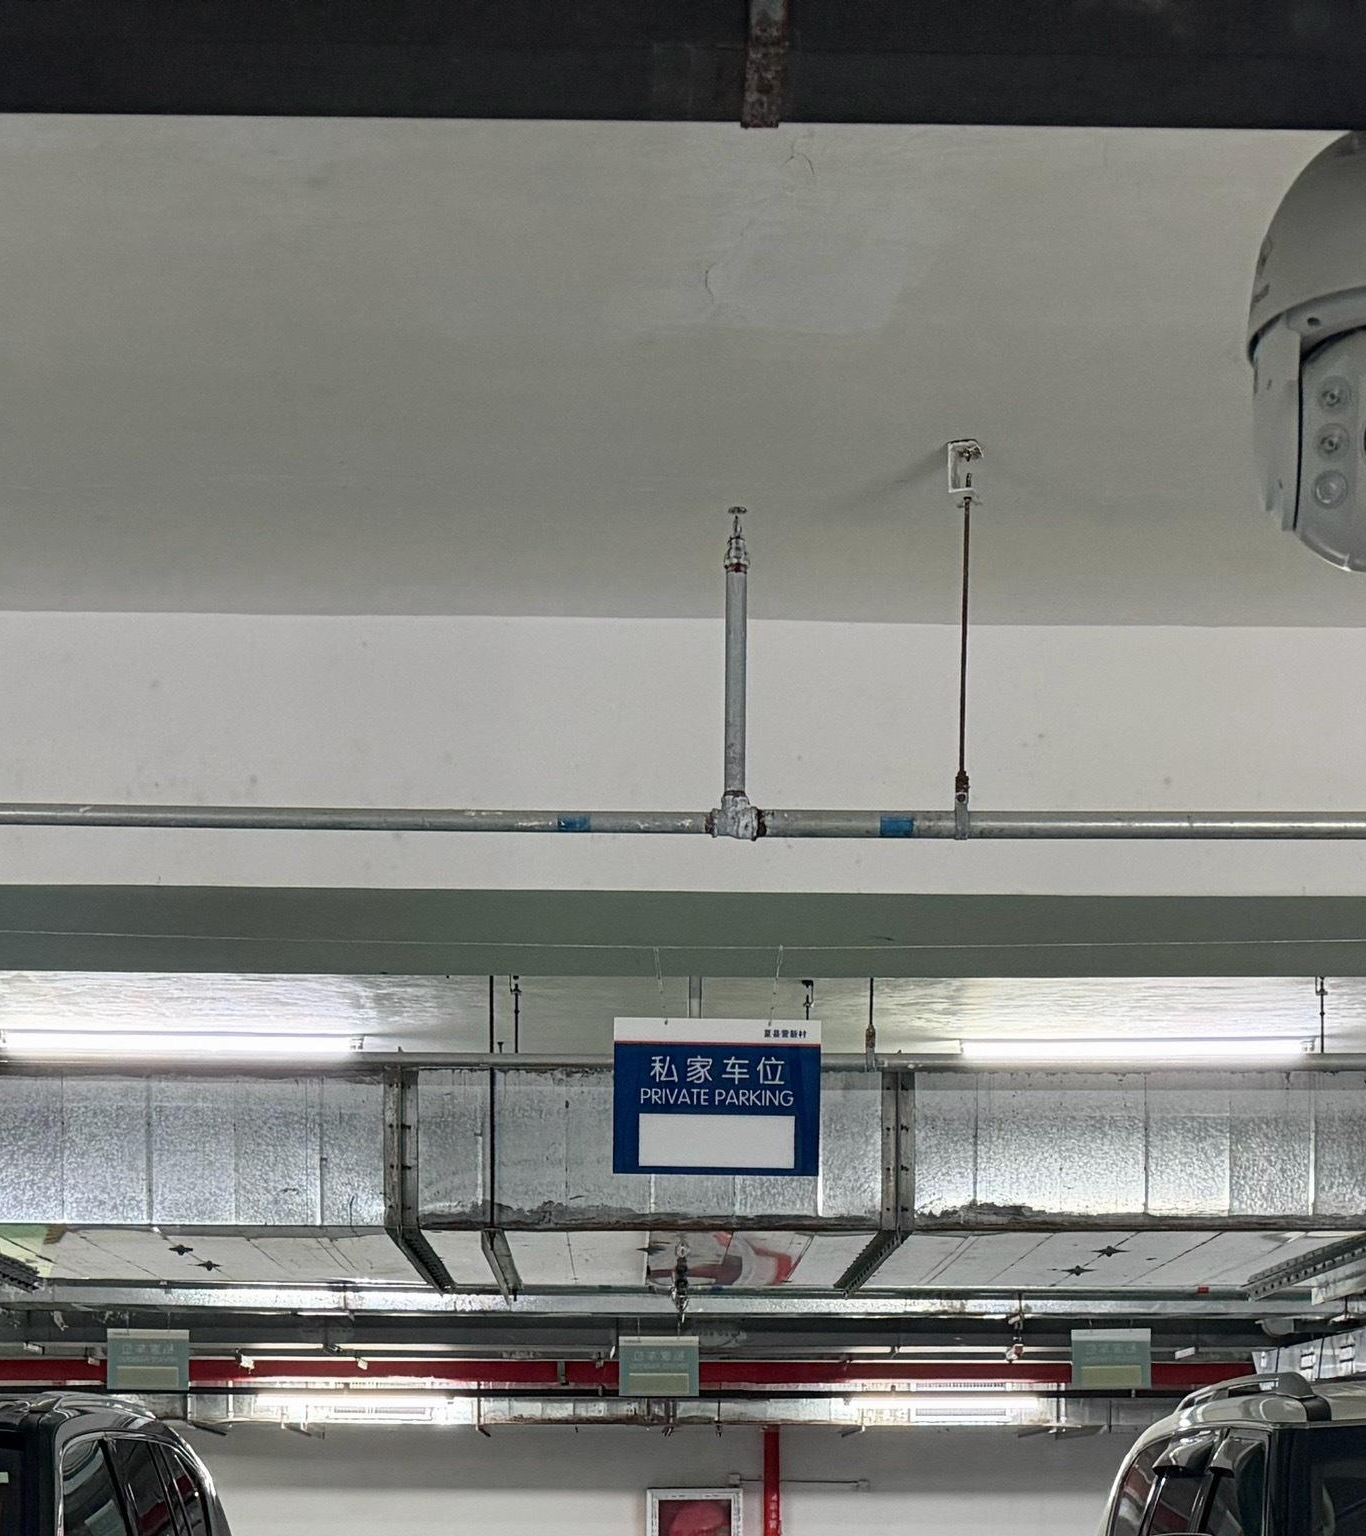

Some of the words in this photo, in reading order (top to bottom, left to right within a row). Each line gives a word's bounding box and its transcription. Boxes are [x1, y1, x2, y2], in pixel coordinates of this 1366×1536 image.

[650, 1055, 785, 1085] 私家车位
[640, 1088, 709, 1106] PRIVATE
[715, 1089, 795, 1107] PARKING
